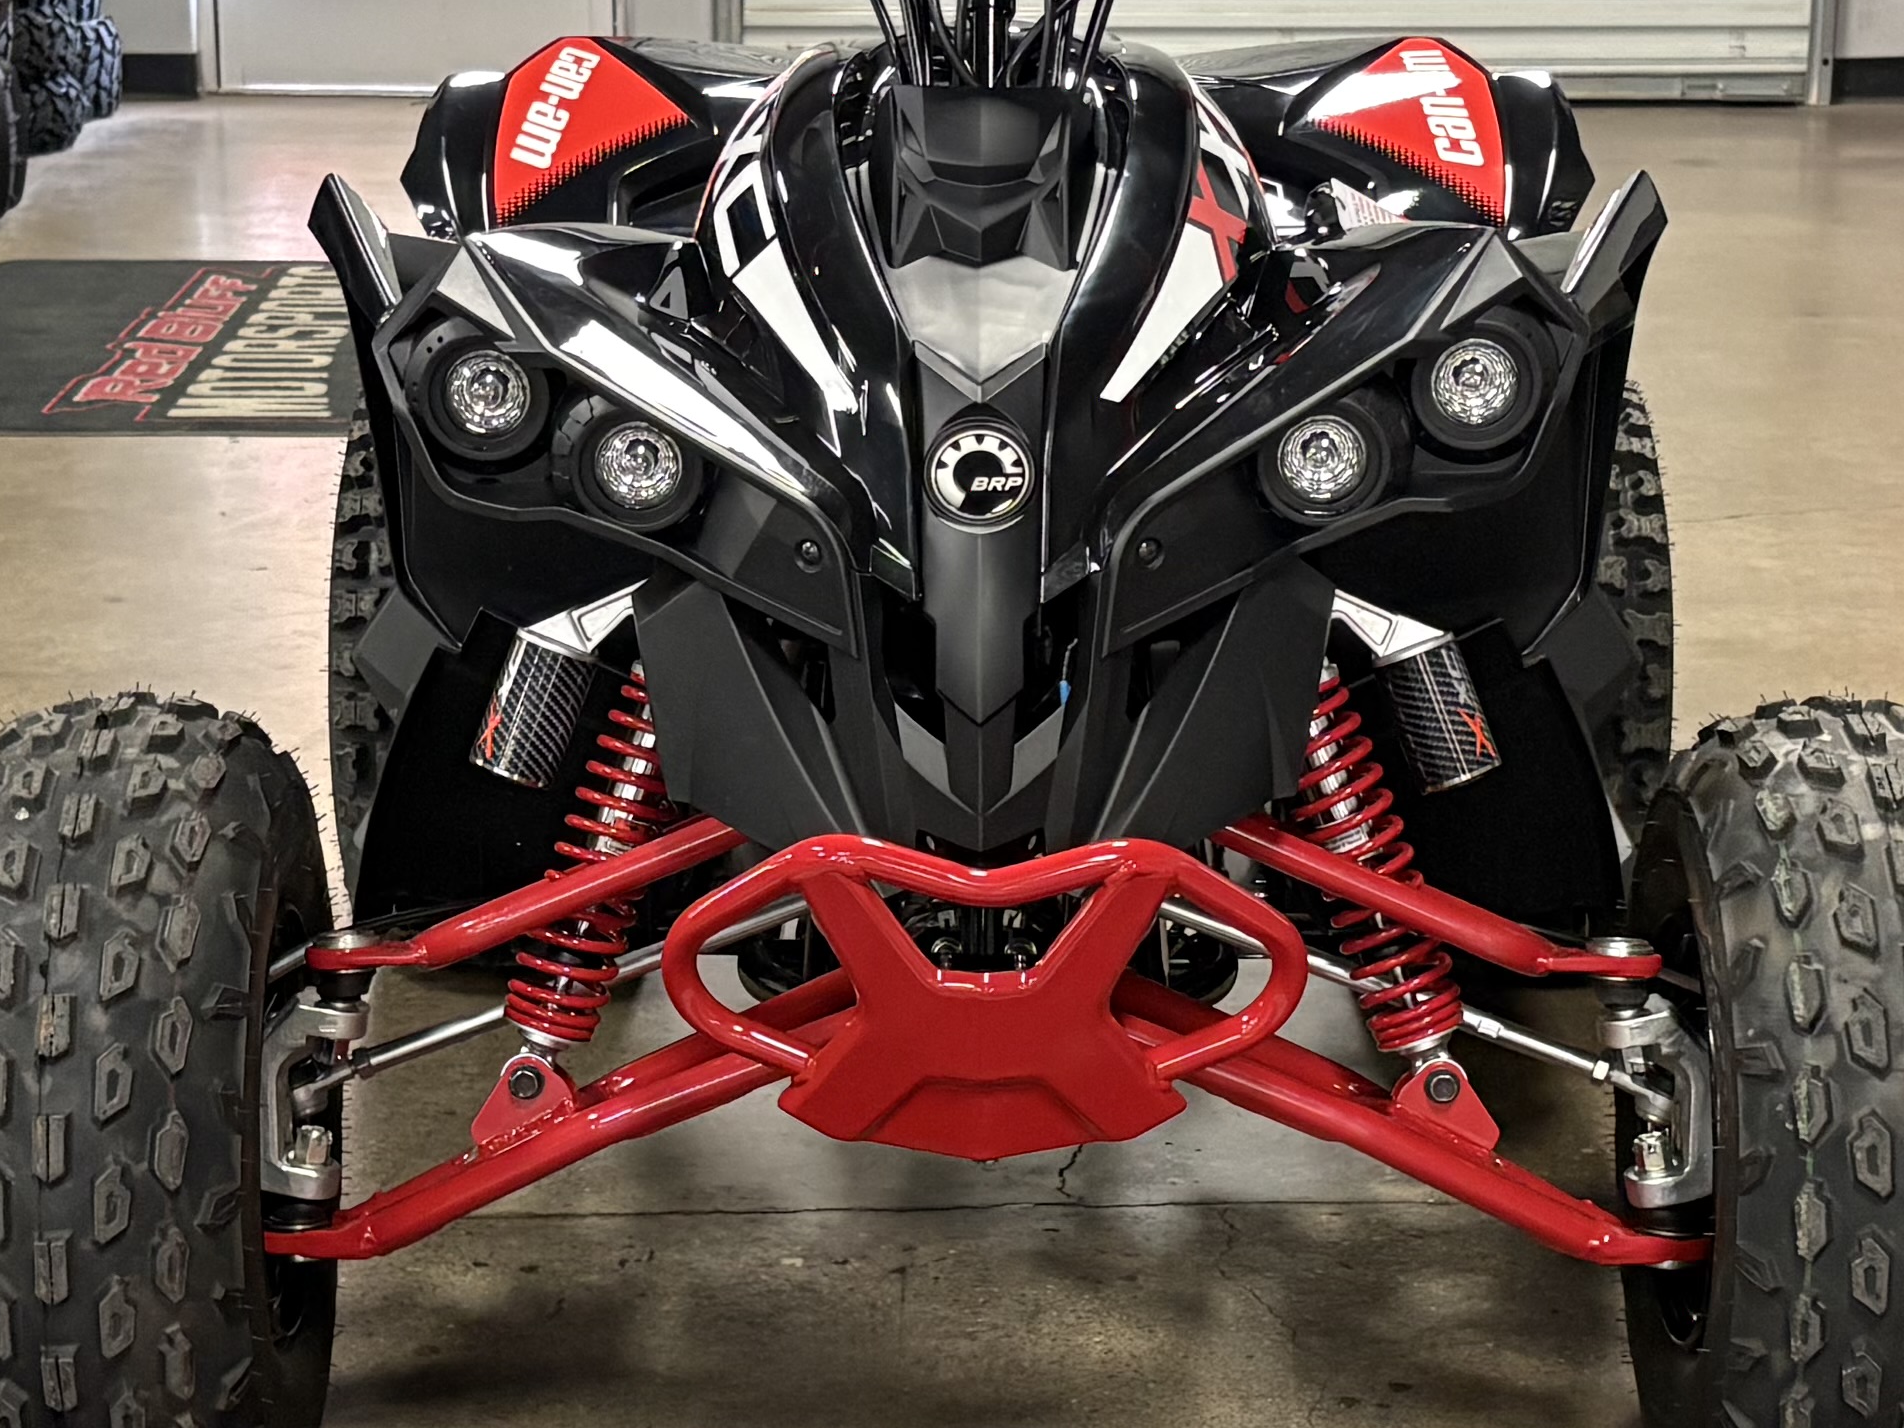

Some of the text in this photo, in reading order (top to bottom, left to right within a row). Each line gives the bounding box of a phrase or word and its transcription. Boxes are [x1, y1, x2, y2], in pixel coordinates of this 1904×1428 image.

[509, 46, 601, 169] can-am
[1399, 49, 1485, 167] can-m
[970, 476, 1024, 492] BRP
